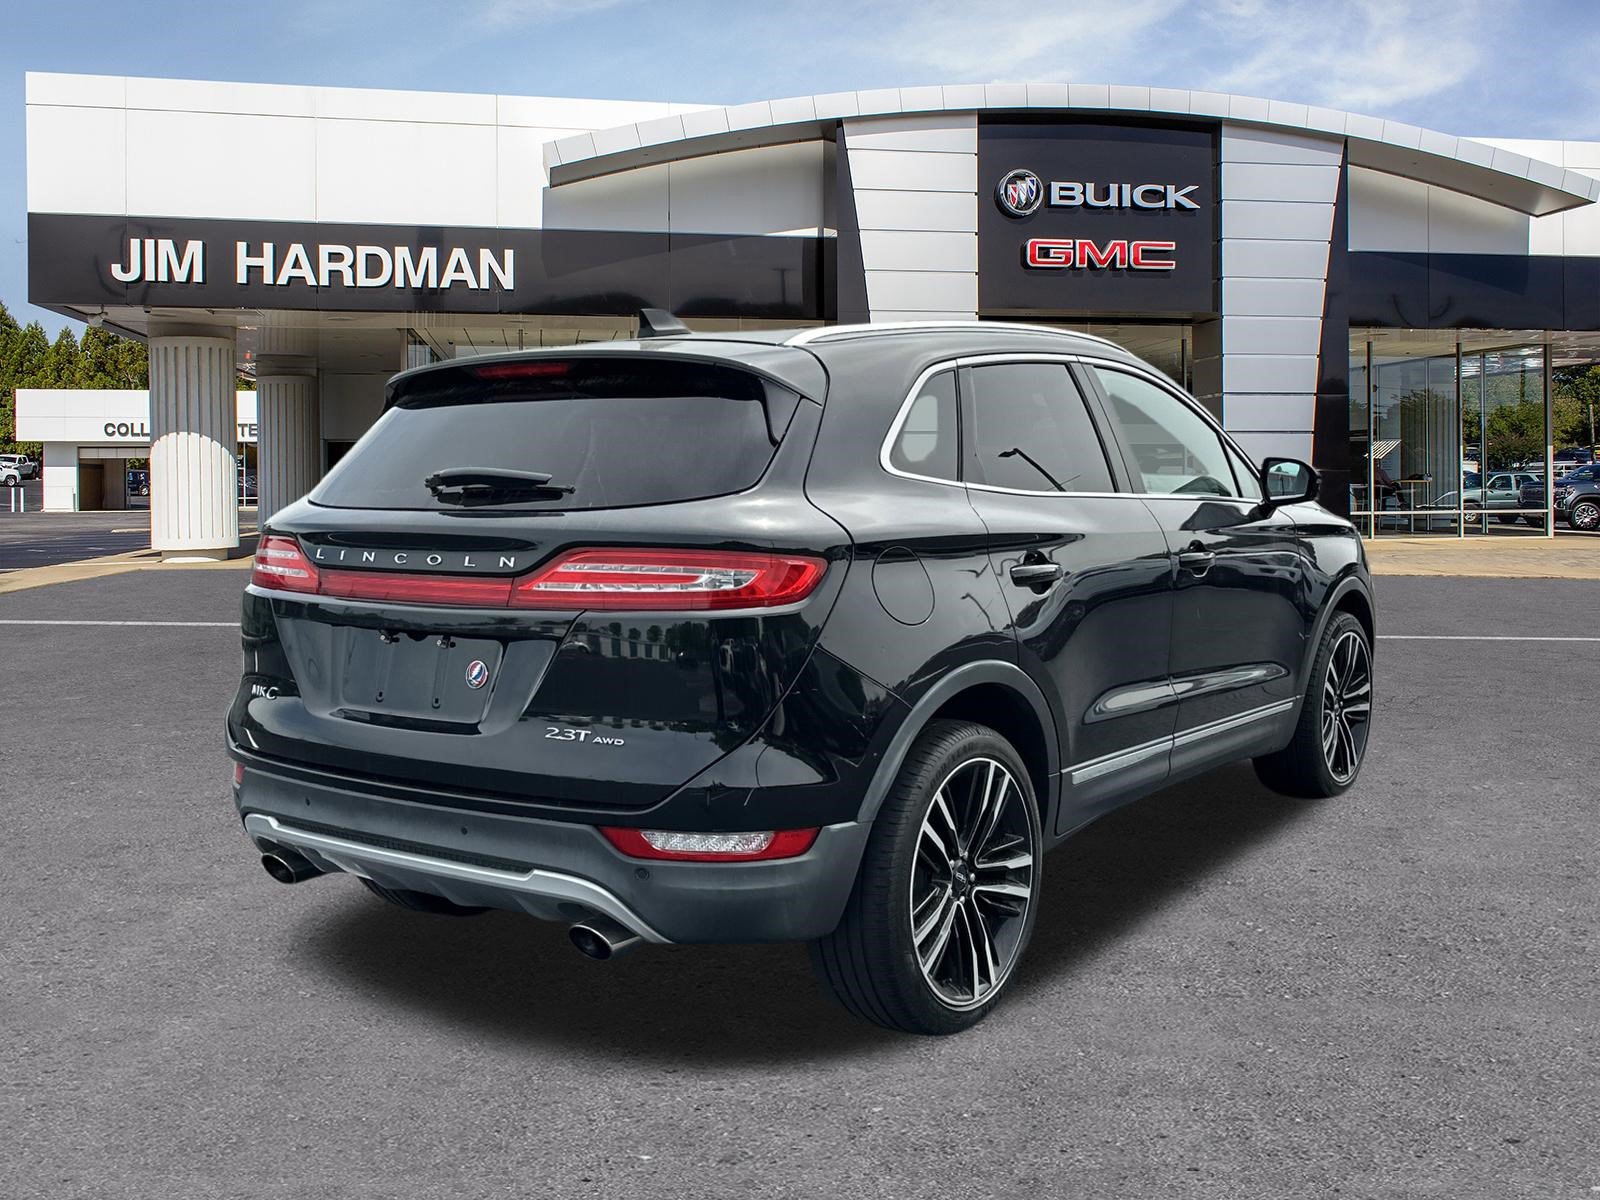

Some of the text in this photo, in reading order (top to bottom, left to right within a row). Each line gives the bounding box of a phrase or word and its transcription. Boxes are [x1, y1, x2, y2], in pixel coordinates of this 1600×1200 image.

[1050, 181, 1200, 209] BUICK
[111, 238, 515, 290] JIM HARDMAN
[1025, 238, 1177, 270] GMC
[315, 548, 516, 568] LINCOLN
[251, 684, 279, 700] MKC
[592, 736, 625, 746] AWD
